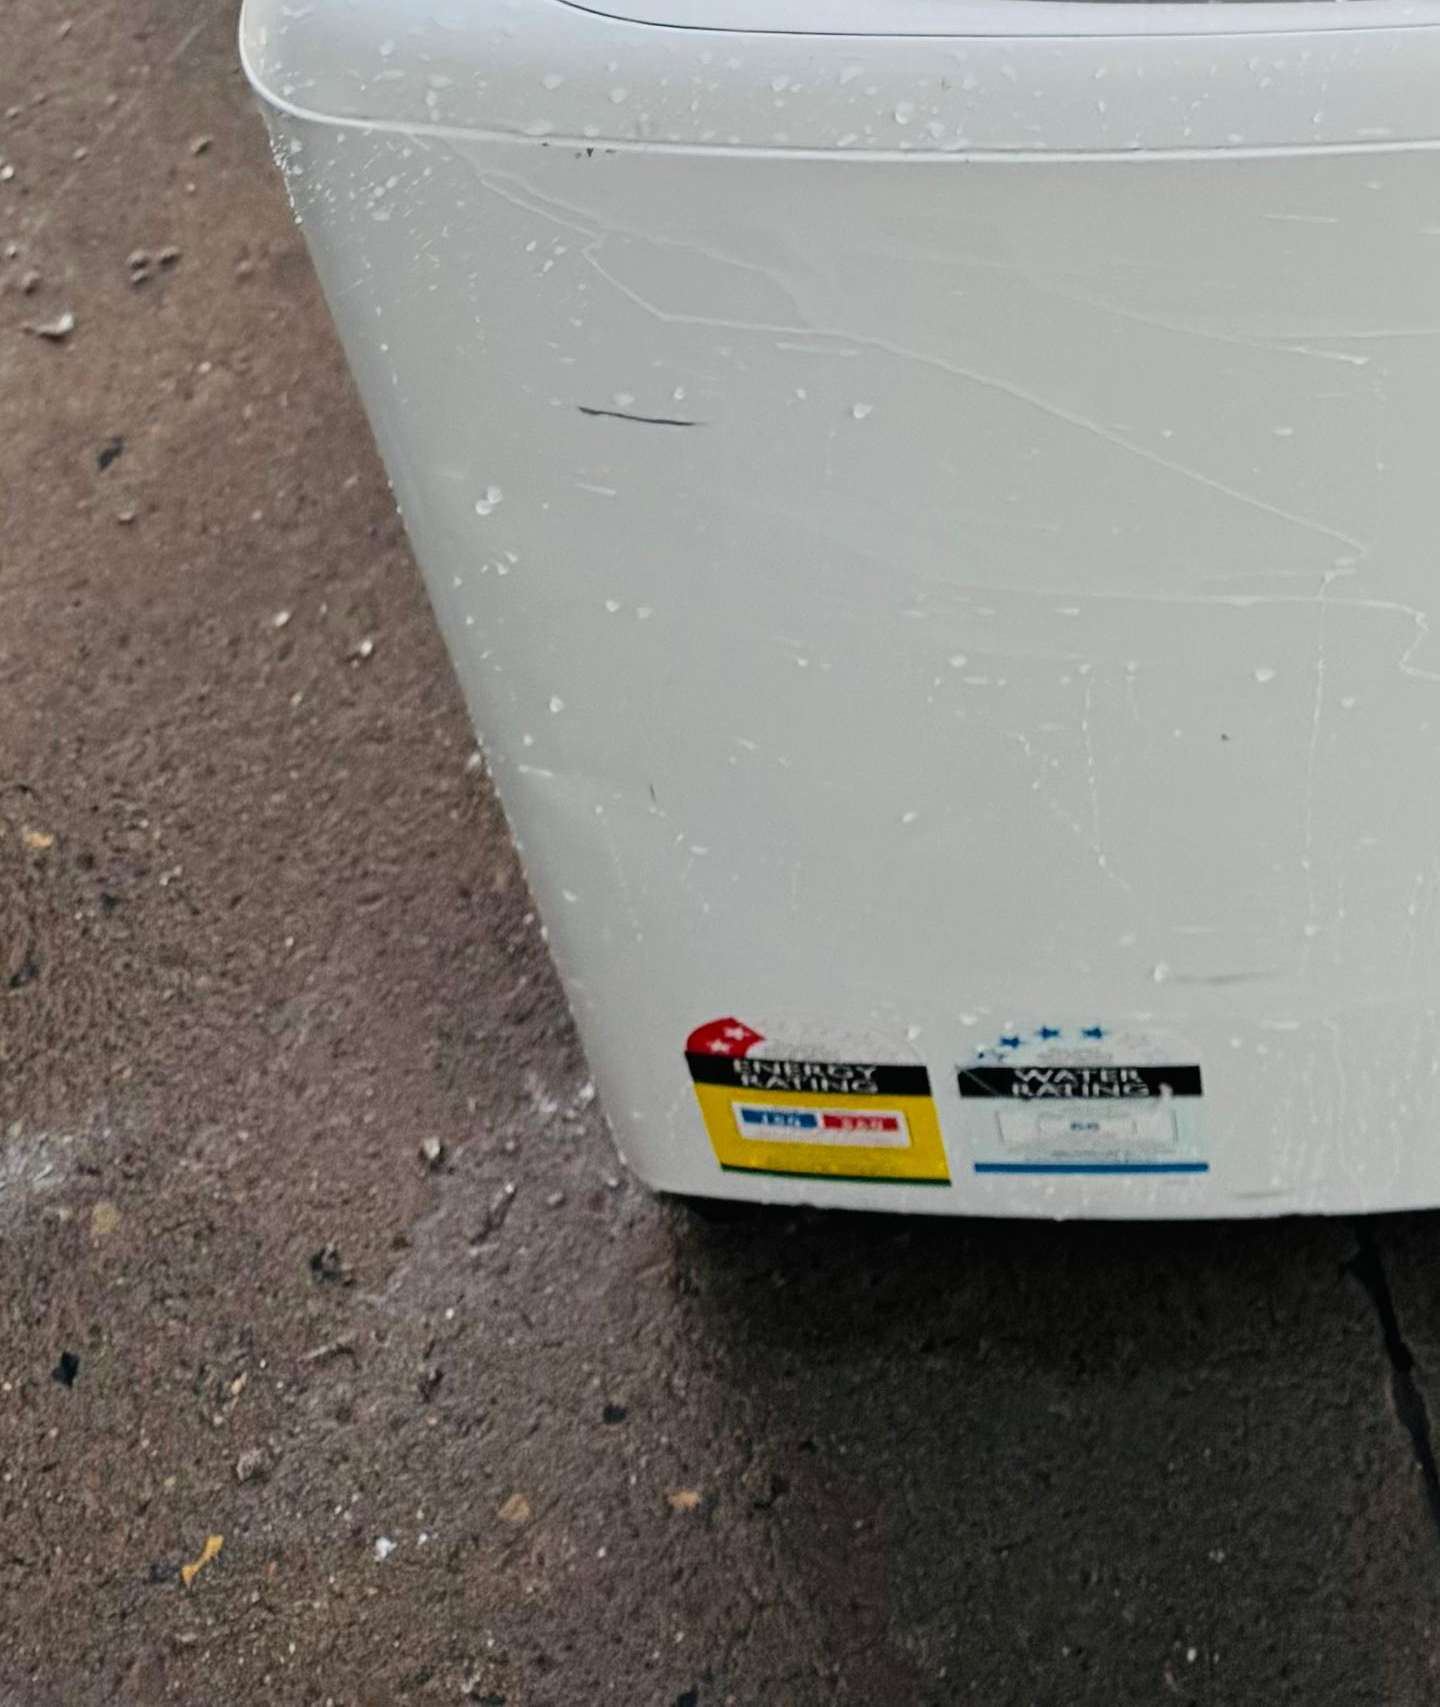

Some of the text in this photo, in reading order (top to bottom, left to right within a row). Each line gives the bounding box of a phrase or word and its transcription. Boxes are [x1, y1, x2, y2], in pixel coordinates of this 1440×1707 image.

[733, 1059, 877, 1079] ENERGY
[1013, 1068, 1143, 1083] WATER
[741, 1074, 879, 1094] RATING
[1011, 1083, 1150, 1099] RATING
